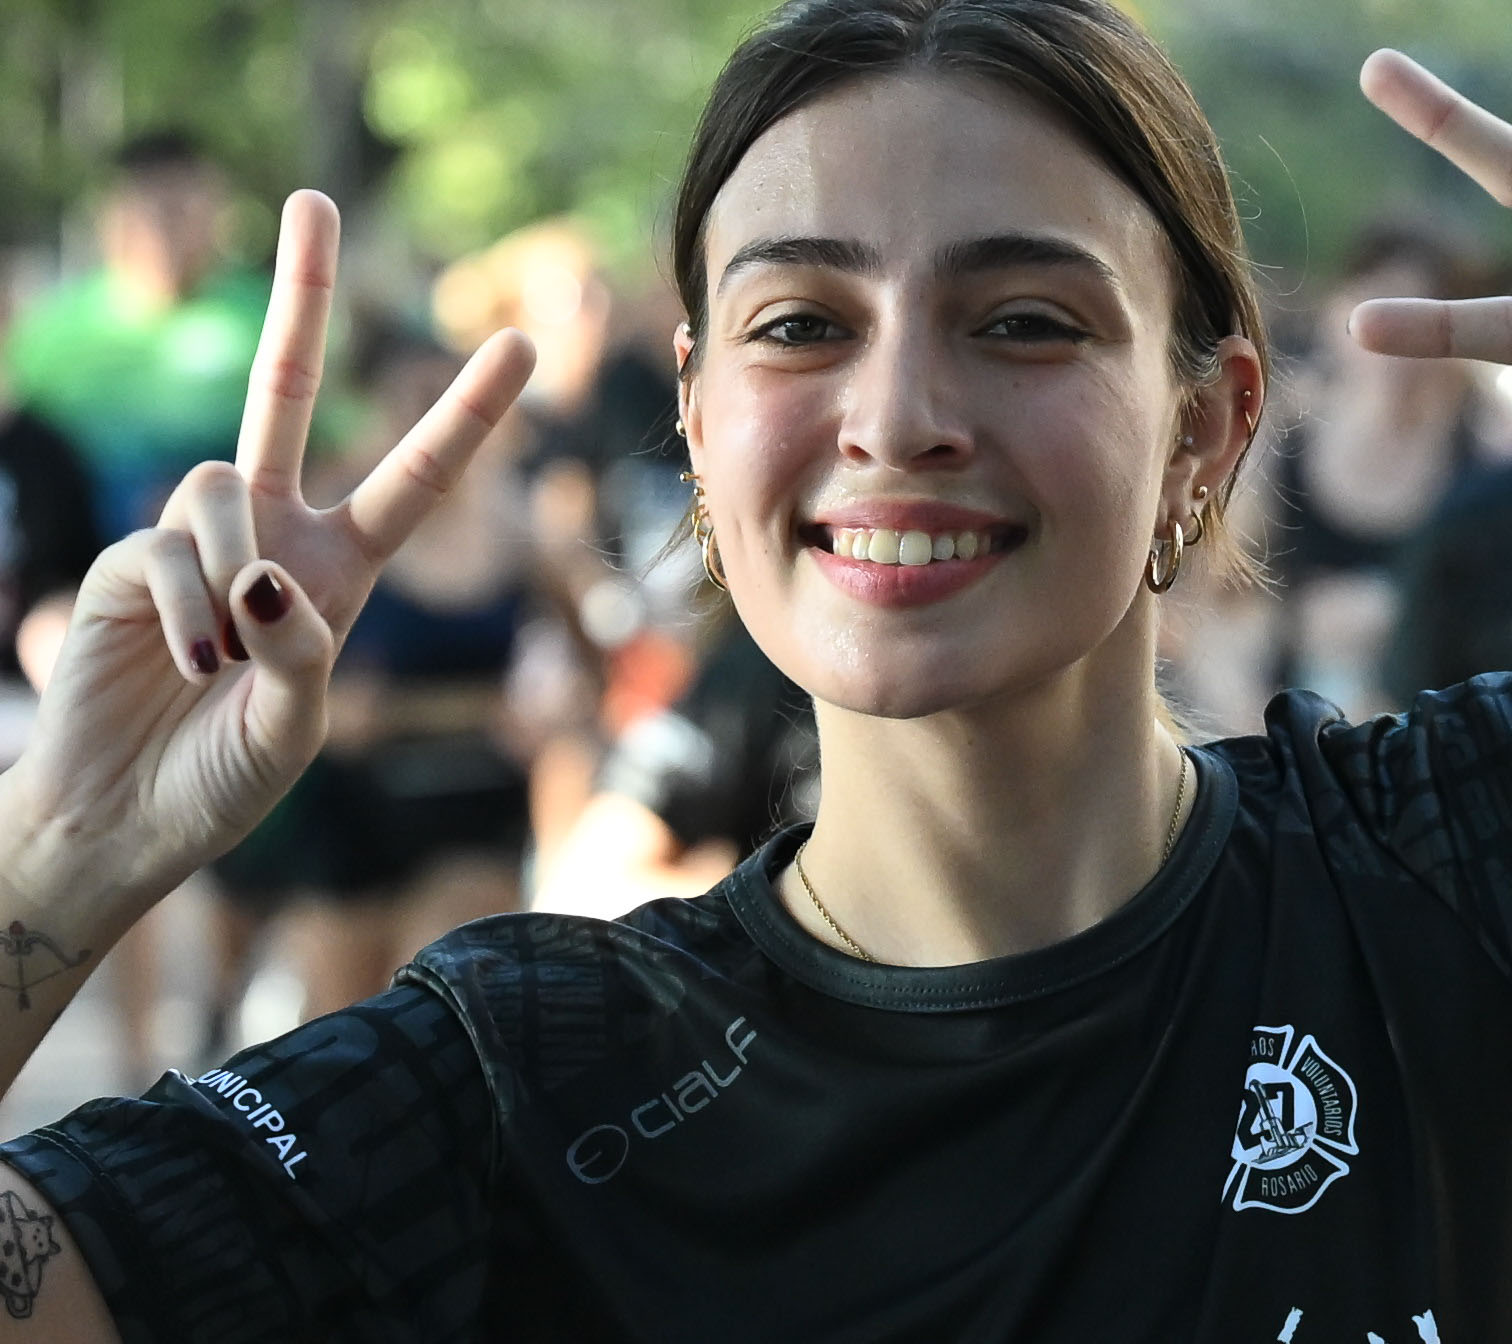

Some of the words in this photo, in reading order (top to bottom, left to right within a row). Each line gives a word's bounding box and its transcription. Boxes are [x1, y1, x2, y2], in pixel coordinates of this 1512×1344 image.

[183, 1067, 308, 1181] UNICIPAL
[1299, 1055, 1343, 1137] VOLUNTARIOS
[1260, 1163, 1319, 1197] ROSARIO
